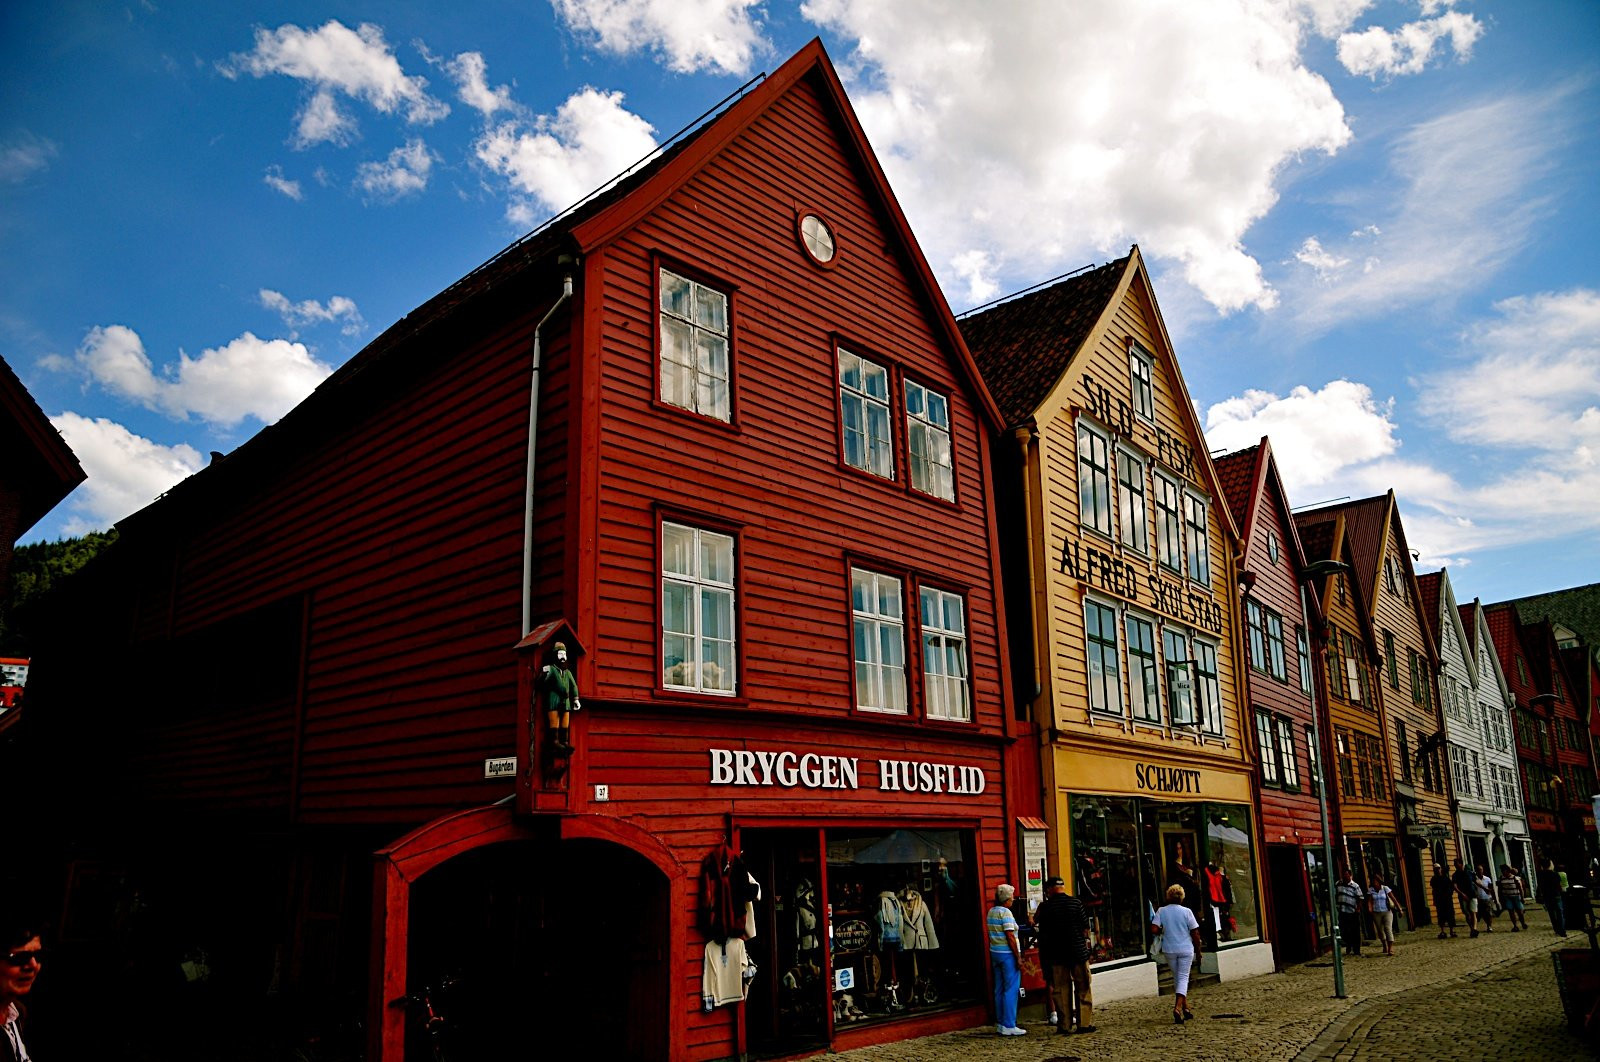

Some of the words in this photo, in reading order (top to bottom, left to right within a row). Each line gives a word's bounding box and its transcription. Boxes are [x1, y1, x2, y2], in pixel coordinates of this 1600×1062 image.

[1081, 373, 1133, 440] SILD
[1156, 426, 1197, 481] FISK
[1060, 535, 1138, 601] ALFRED
[1148, 574, 1223, 635] SKULSTAD
[709, 748, 859, 790] BRYGGEN
[878, 759, 986, 795] HUSFLID
[1135, 762, 1202, 794] SCHJØTT
